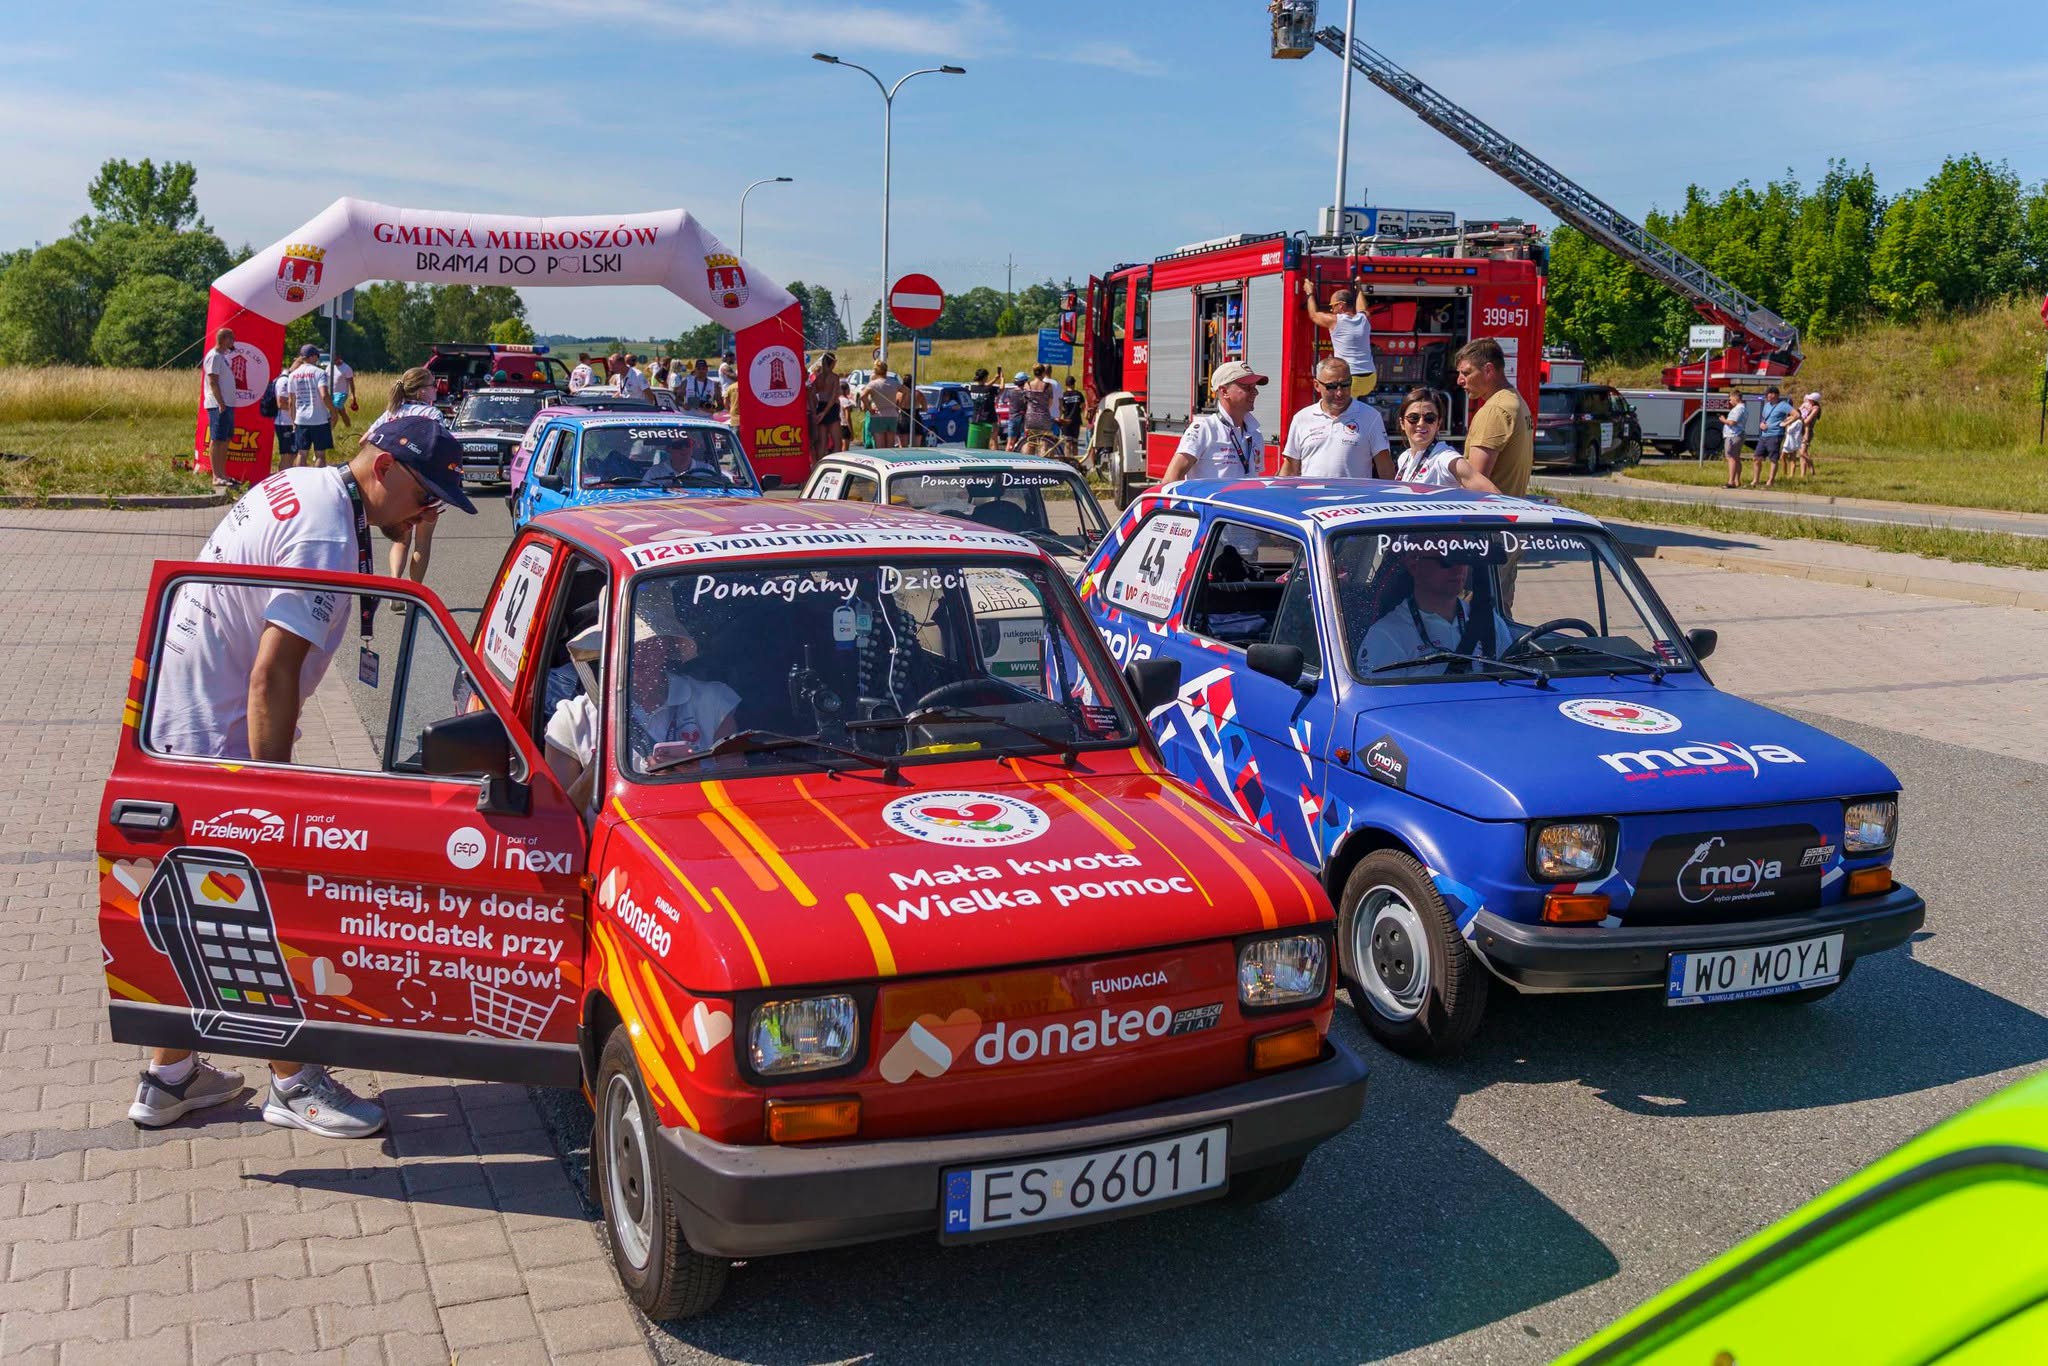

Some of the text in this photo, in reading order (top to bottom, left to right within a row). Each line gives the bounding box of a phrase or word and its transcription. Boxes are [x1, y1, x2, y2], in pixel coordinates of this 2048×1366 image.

[1344, 214, 1363, 231] PL
[373, 222, 659, 250] GMINA MIEROSZÓW
[416, 252, 488, 273] BRAMA
[499, 255, 536, 274] DO
[489, 395, 520, 403] Senetic
[628, 428, 688, 440] Senetic
[755, 425, 802, 447] MCK
[921, 473, 1060, 489] Pomagamy Dzieciom
[879, 532, 1030, 549] STARS4STARS
[1169, 526, 1192, 538] BIELSKO
[1377, 531, 1586, 556] Pomagamy Dzieciom
[1138, 537, 1172, 587] 45
[692, 575, 859, 605] Pomagamy
[505, 574, 529, 640] 42
[1003, 629, 1042, 638] rutkowski
[1018, 636, 1041, 645] group
[1374, 752, 1402, 773] moya
[1598, 740, 1806, 779] moya
[306, 814, 336, 824] part of
[897, 791, 1041, 825] Wyprawa Maluchów
[191, 819, 367, 851] Przelewy24 nexi
[891, 810, 928, 837] Wielka
[941, 828, 1034, 843] dla Dzieci
[507, 835, 538, 846] part of
[1805, 846, 1835, 857] POLSKI
[505, 847, 573, 874] nexi
[889, 852, 1142, 892] Mała kwota
[1802, 854, 1831, 866] FIAT
[1700, 857, 1782, 891] moya
[307, 874, 565, 924] Pamiętaj, by dodać
[654, 895, 680, 924] FUNDACJA
[876, 875, 1194, 925] Wielka pomoc
[617, 888, 671, 958] donateo
[340, 912, 564, 962] mikrodatek przy
[342, 945, 562, 990] okazji zakupów!
[1695, 941, 1829, 992] WO MOYA
[1091, 970, 1168, 995] FUNDACJA
[1669, 981, 1682, 991] PL
[1173, 1015, 1220, 1034] FIAT
[1174, 1003, 1224, 1021] POLSKI
[974, 1005, 1173, 1066] donateo
[982, 1136, 1210, 1223] ES 66011
[949, 1208, 967, 1224] PL
